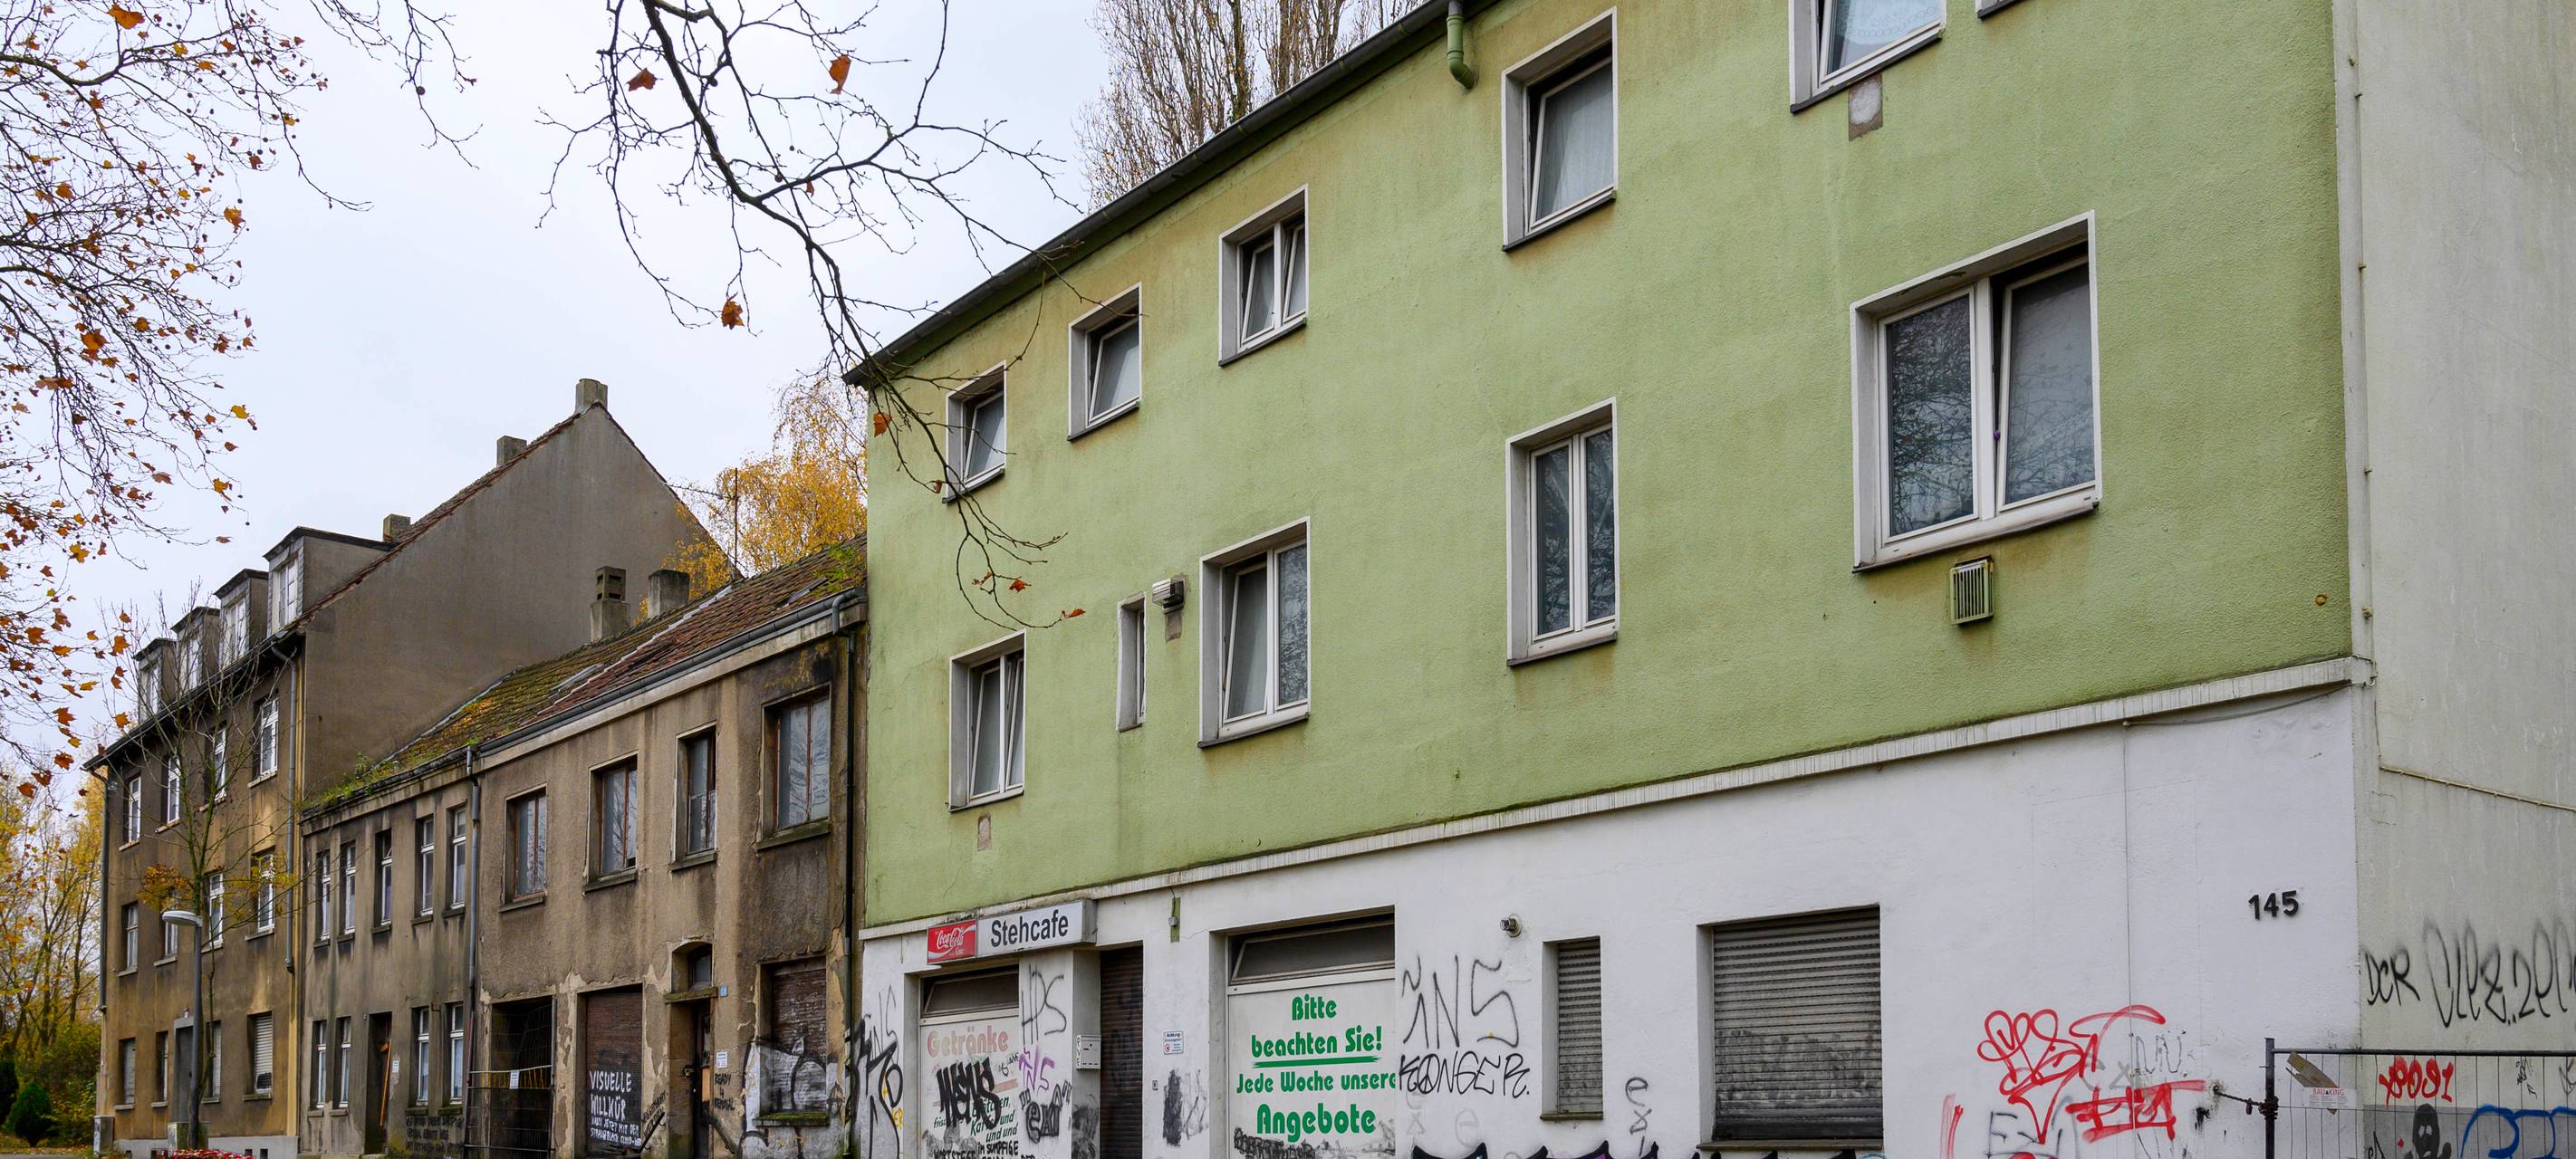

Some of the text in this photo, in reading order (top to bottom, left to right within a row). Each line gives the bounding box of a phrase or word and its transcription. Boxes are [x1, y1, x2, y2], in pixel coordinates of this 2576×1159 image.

[2248, 890, 2299, 920] 145
[991, 909, 1069, 948] Stehcafe
[1292, 993, 1338, 1021] Bitte
[927, 1025, 1009, 1058] Getränke
[1251, 1025, 1382, 1058] beachten Sie!
[589, 1071, 631, 1093] VISUELLE
[1236, 1073, 1274, 1094] Jede
[1280, 1070, 1334, 1093] Woche
[591, 1094, 627, 1122] WILLKÜR
[999, 1109, 1015, 1125] und
[985, 1123, 1018, 1143] und und
[1256, 1102, 1377, 1143] Angebote
